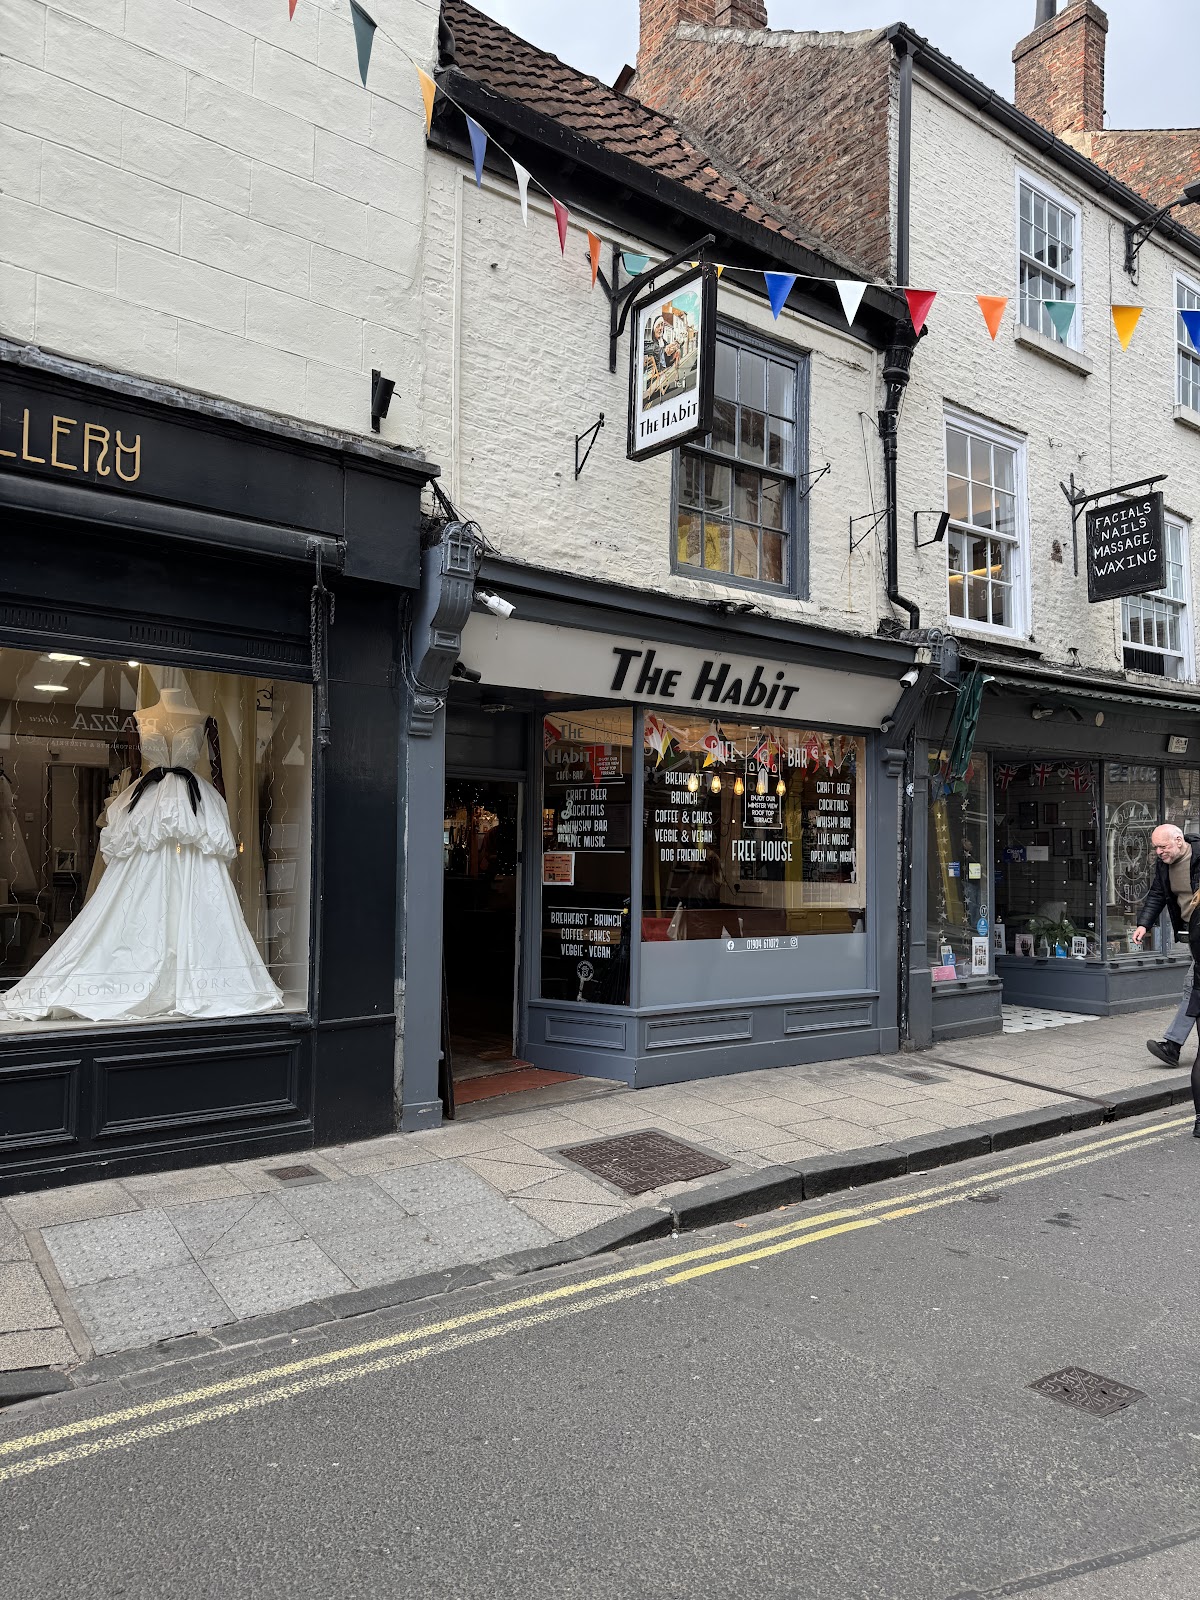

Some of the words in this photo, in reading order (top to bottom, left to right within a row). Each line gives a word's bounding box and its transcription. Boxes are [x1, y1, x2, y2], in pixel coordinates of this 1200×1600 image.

[639, 418, 659, 438] The
[661, 400, 698, 429] Habit
[1095, 502, 1152, 529] FACIALS
[1101, 517, 1147, 541] NAILS
[1094, 533, 1150, 560] MASSAGE
[1095, 549, 1157, 577] WAXING
[610, 647, 682, 698] The
[691, 660, 800, 711] Habit
[559, 724, 584, 740] The
[551, 747, 592, 765] Habit
[787, 747, 808, 768] BAR
[665, 771, 704, 787] BREAKFST
[566, 789, 588, 801] CRAFT
[590, 789, 607, 801] BEER
[816, 781, 835, 794] CRAFT
[836, 783, 851, 795] BEER
[670, 790, 698, 805] BRUNCH
[818, 798, 849, 812] COCKTAILS
[655, 809, 679, 823] COFFEE
[682, 810, 690, 823] &
[691, 811, 713, 824] CAKES
[816, 816, 839, 828] WHISKY
[839, 816, 851, 829] BAR
[594, 820, 608, 832] BAR
[583, 836, 606, 848] MUSIC
[654, 828, 679, 842] VEGGIE
[681, 829, 689, 843] &
[691, 829, 713, 843] VEGAN
[817, 833, 830, 846] LIVE
[831, 834, 850, 847] MUSIC
[660, 848, 675, 862] DOG
[676, 848, 707, 862] FRIENDLY
[731, 839, 757, 862] FREE
[760, 840, 794, 862] HOUSE
[810, 850, 825, 864] OPEN
[826, 851, 838, 863] MIC
[550, 911, 588, 926] BREAKFAST
[594, 913, 622, 927] BRUNCH
[560, 927, 584, 941] COFFEE
[589, 929, 611, 943] CAKES
[560, 943, 584, 957] VEGGIE
[588, 945, 611, 959] VEGAN
[77, 982, 162, 997] LONDON
[184, 978, 233, 991] YORK
